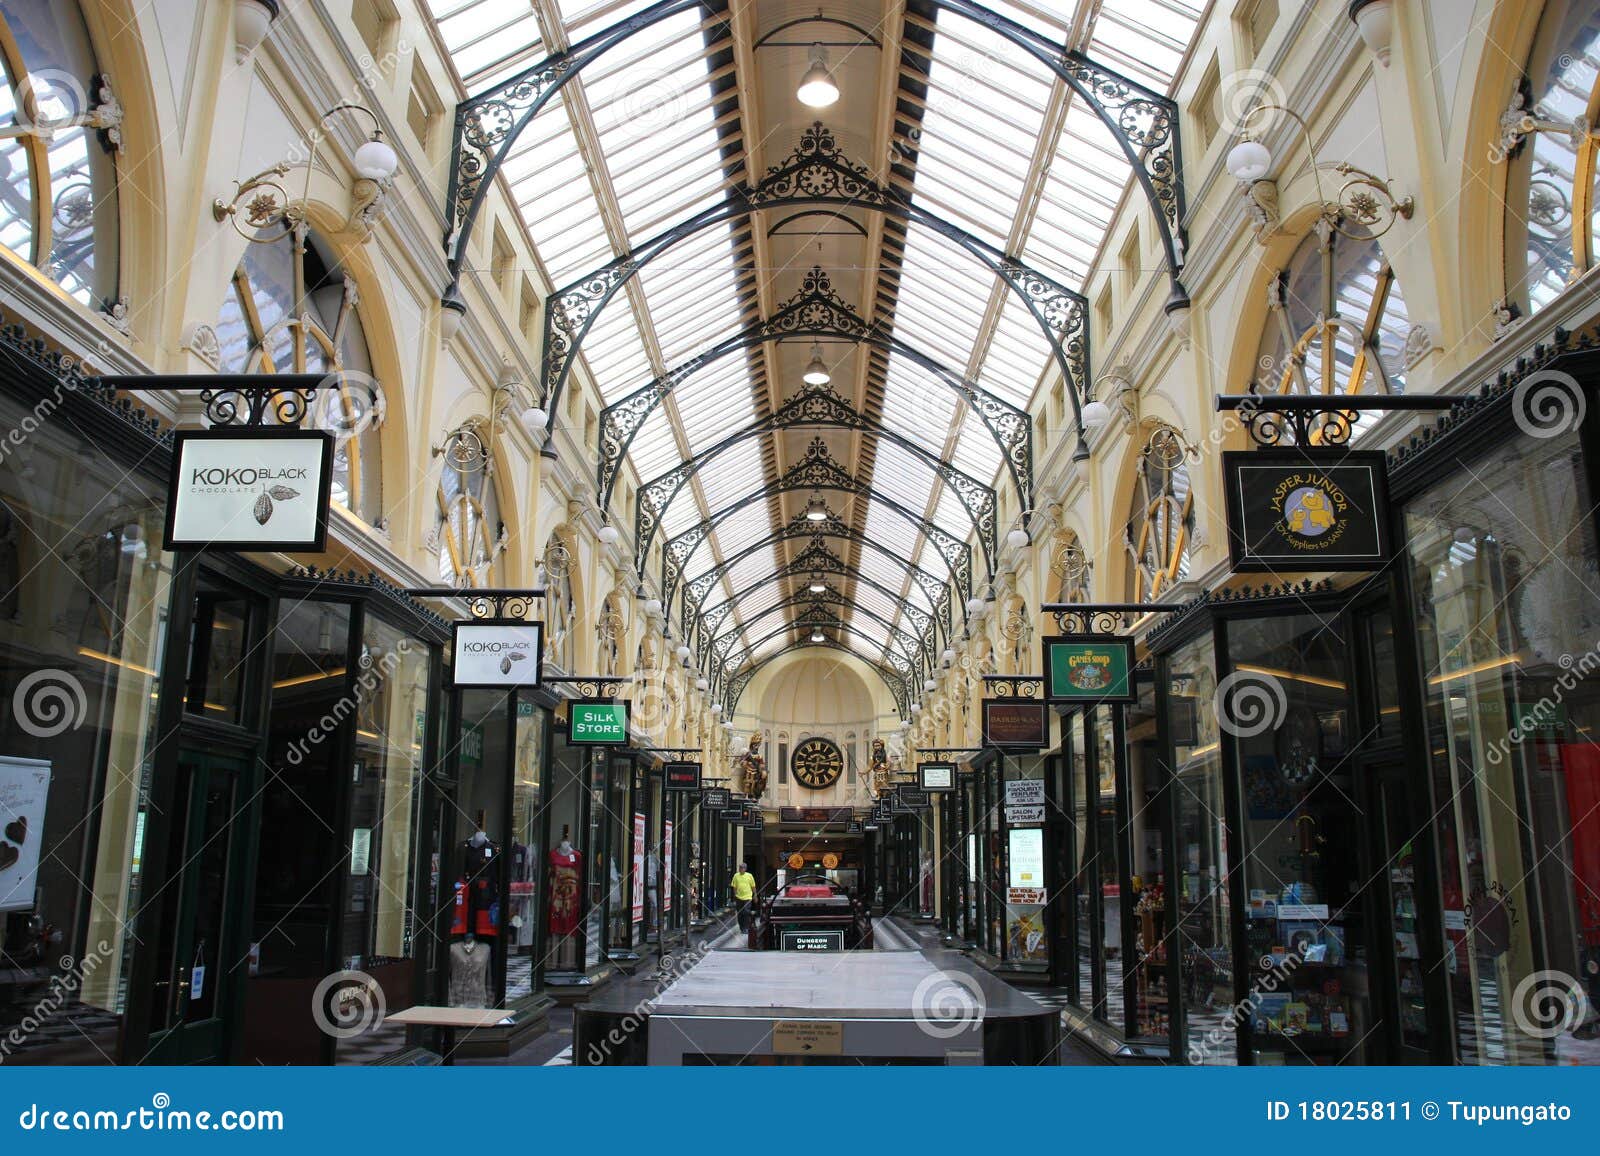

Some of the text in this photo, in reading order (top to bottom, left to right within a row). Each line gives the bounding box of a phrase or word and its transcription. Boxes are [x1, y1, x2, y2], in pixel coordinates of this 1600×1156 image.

[191, 468, 307, 485] KOKO BLACK
[1270, 473, 1347, 512] JASPER JUNIOR
[464, 642, 501, 652] KOKO
[584, 712, 614, 722] SILK
[576, 724, 621, 733] STORE
